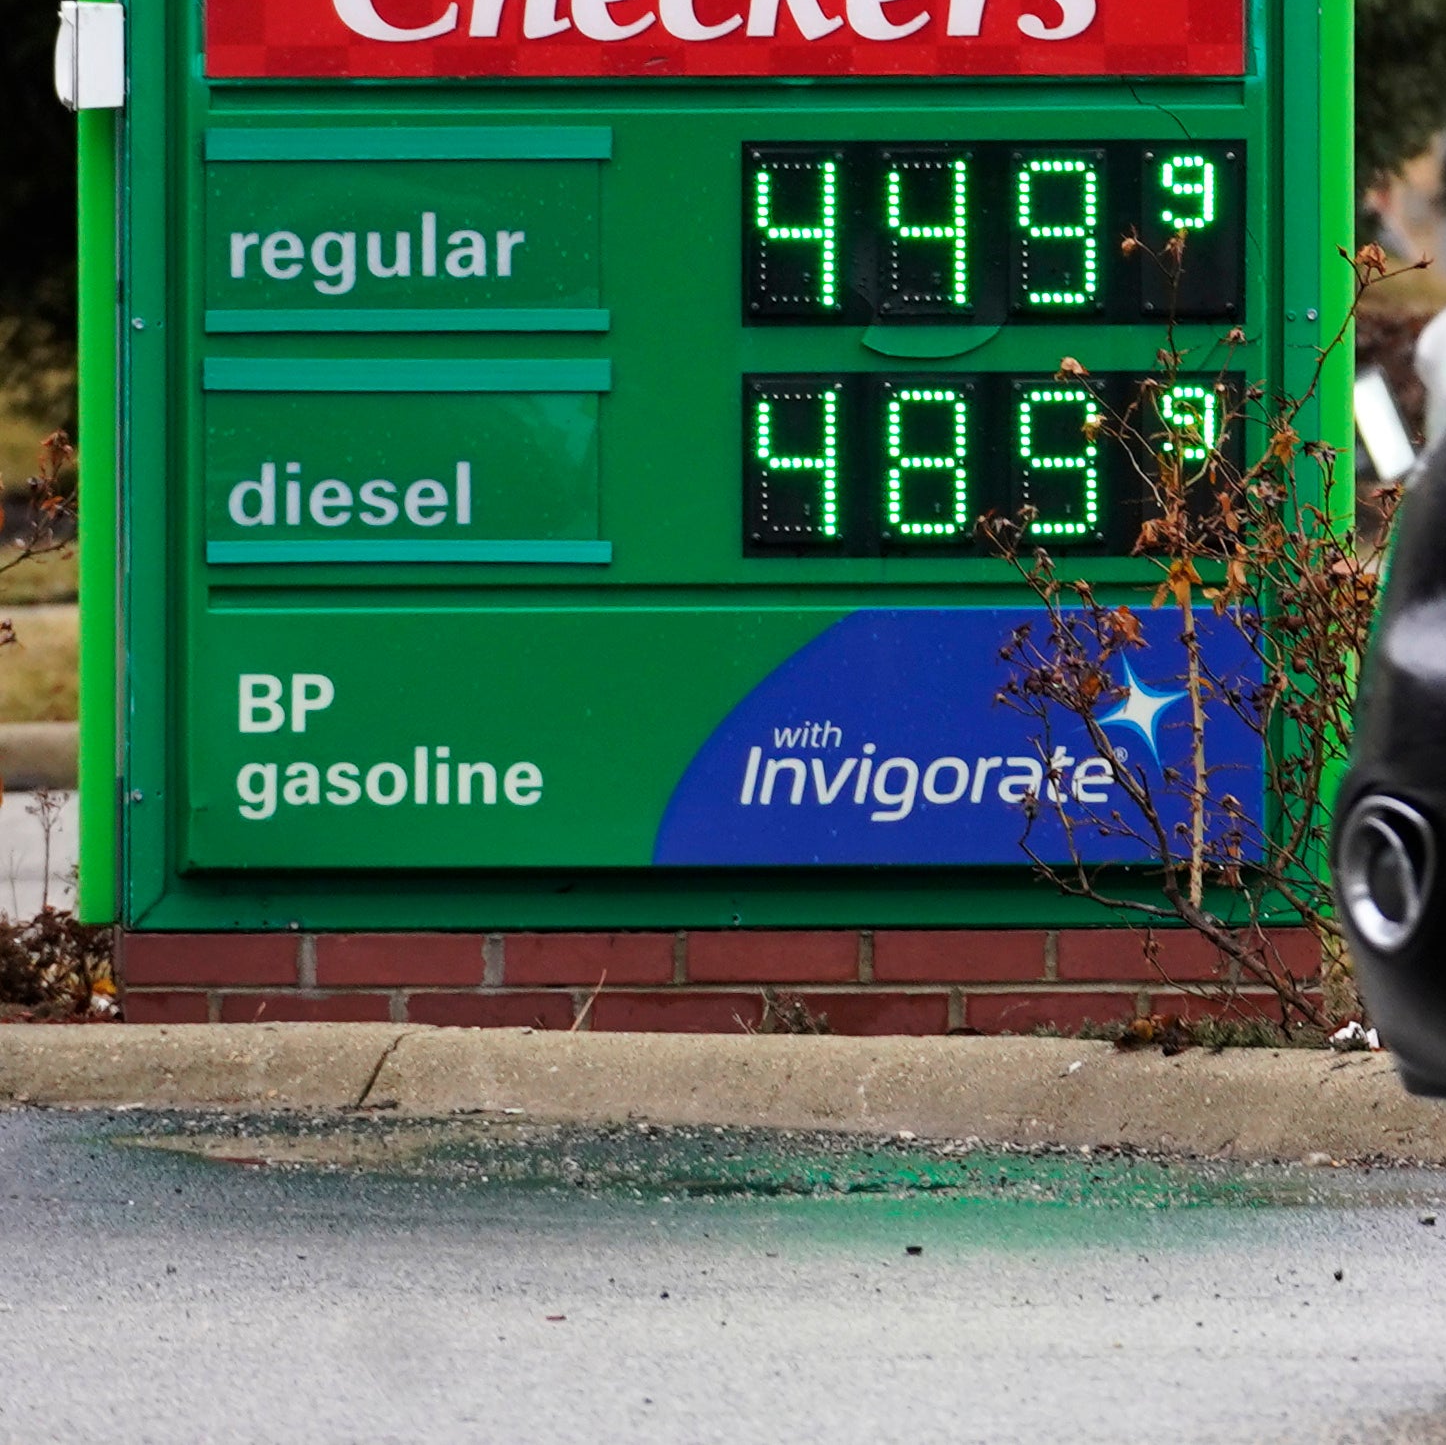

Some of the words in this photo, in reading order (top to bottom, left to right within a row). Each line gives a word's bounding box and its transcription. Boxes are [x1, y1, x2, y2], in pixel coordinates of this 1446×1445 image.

[229, 211, 526, 295] regular
[757, 160, 1097, 306] 449
[1161, 155, 1215, 229] 9
[227, 460, 472, 527] diesel
[238, 673, 336, 734] BP
[773, 720, 842, 749] with
[236, 745, 545, 820] gasoline
